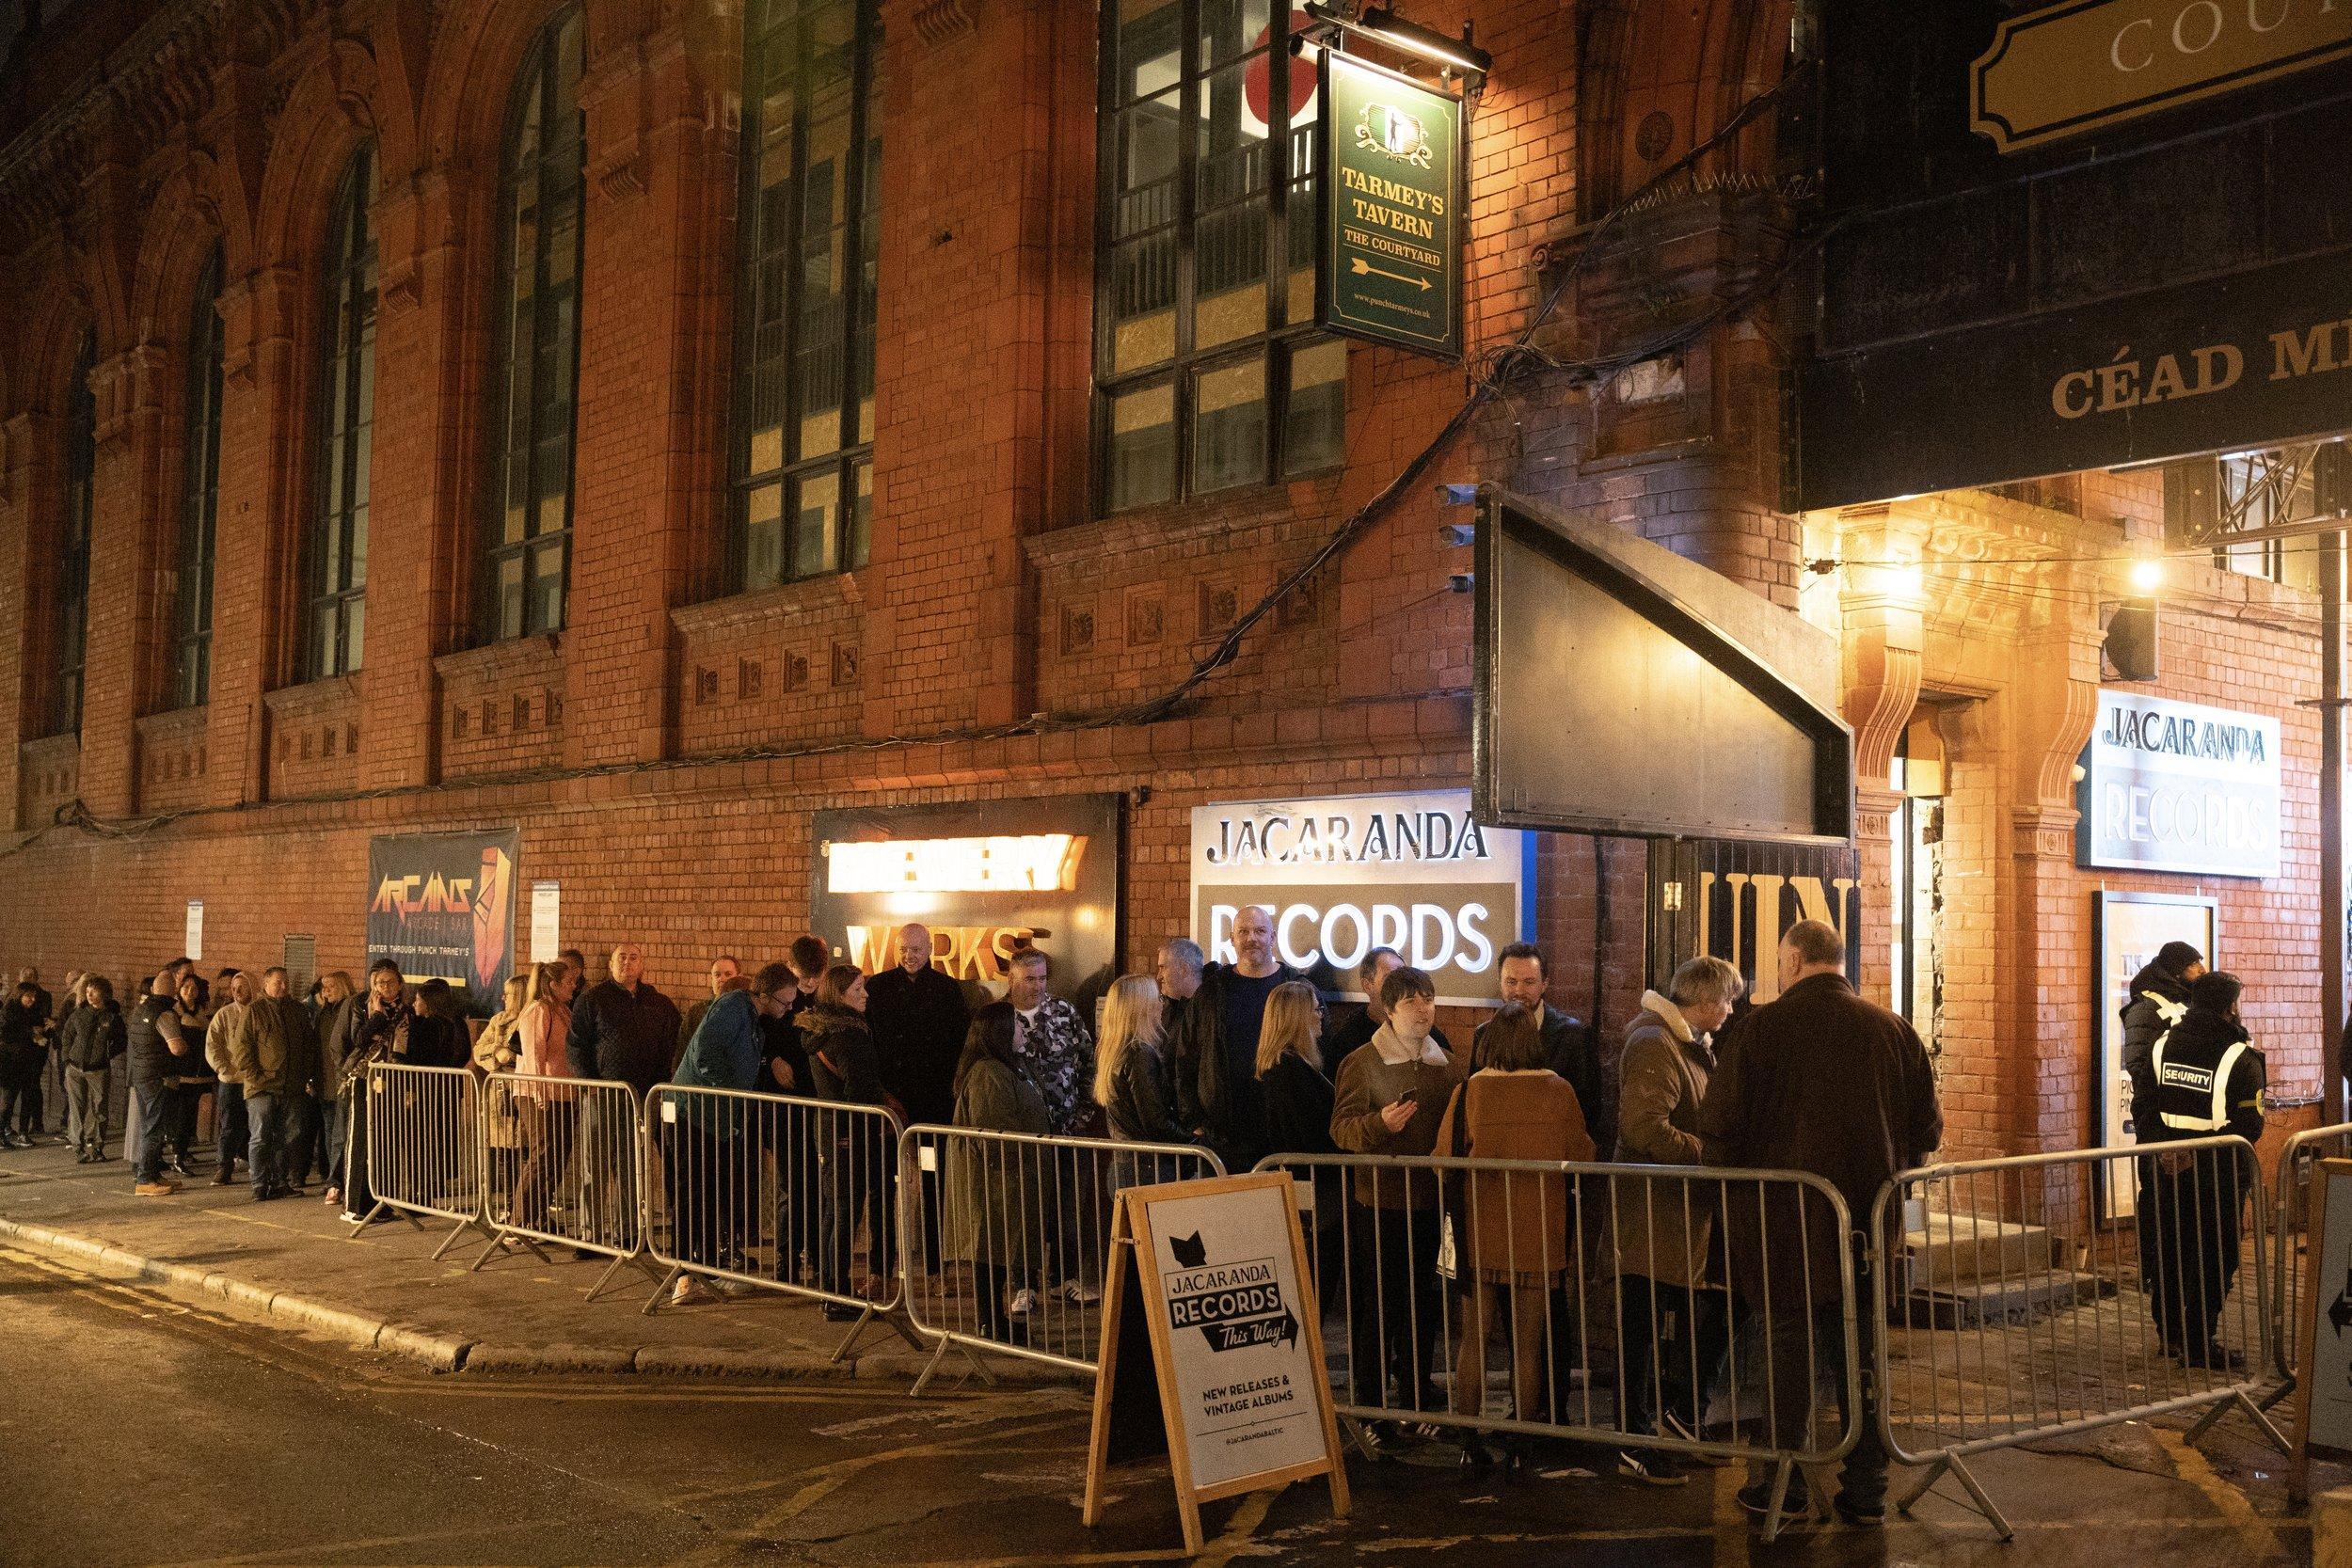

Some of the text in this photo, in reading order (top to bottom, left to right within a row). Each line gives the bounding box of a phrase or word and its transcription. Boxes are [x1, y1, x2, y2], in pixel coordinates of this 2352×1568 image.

[2110, 0, 2336, 72] COU
[1342, 166, 1445, 216] TARMEY'S
[1352, 198, 1434, 240] TAVERN
[1344, 229, 1441, 267] THE COURTYARD
[2051, 344, 2245, 420] CÉAD
[2103, 706, 2265, 764] JACARANDA
[1206, 809, 1490, 864] JACARANDA
[2104, 782, 2267, 850] RECORDS
[368, 944, 388, 954] ENTER
[389, 944, 416, 955] THROUGH
[418, 945, 437, 955] PUNCH
[847, 925, 1033, 981] WRKS
[1211, 902, 1493, 974] RCORDS
[1172, 1264, 1272, 1294] JACARANDA
[1172, 1286, 1279, 1324] RECORDS
[1219, 1319, 1288, 1349] This Way!
[1202, 1374, 1290, 1402] NEW RELEASES &
[1203, 1389, 1295, 1418] VINTAGE ALBUMS
